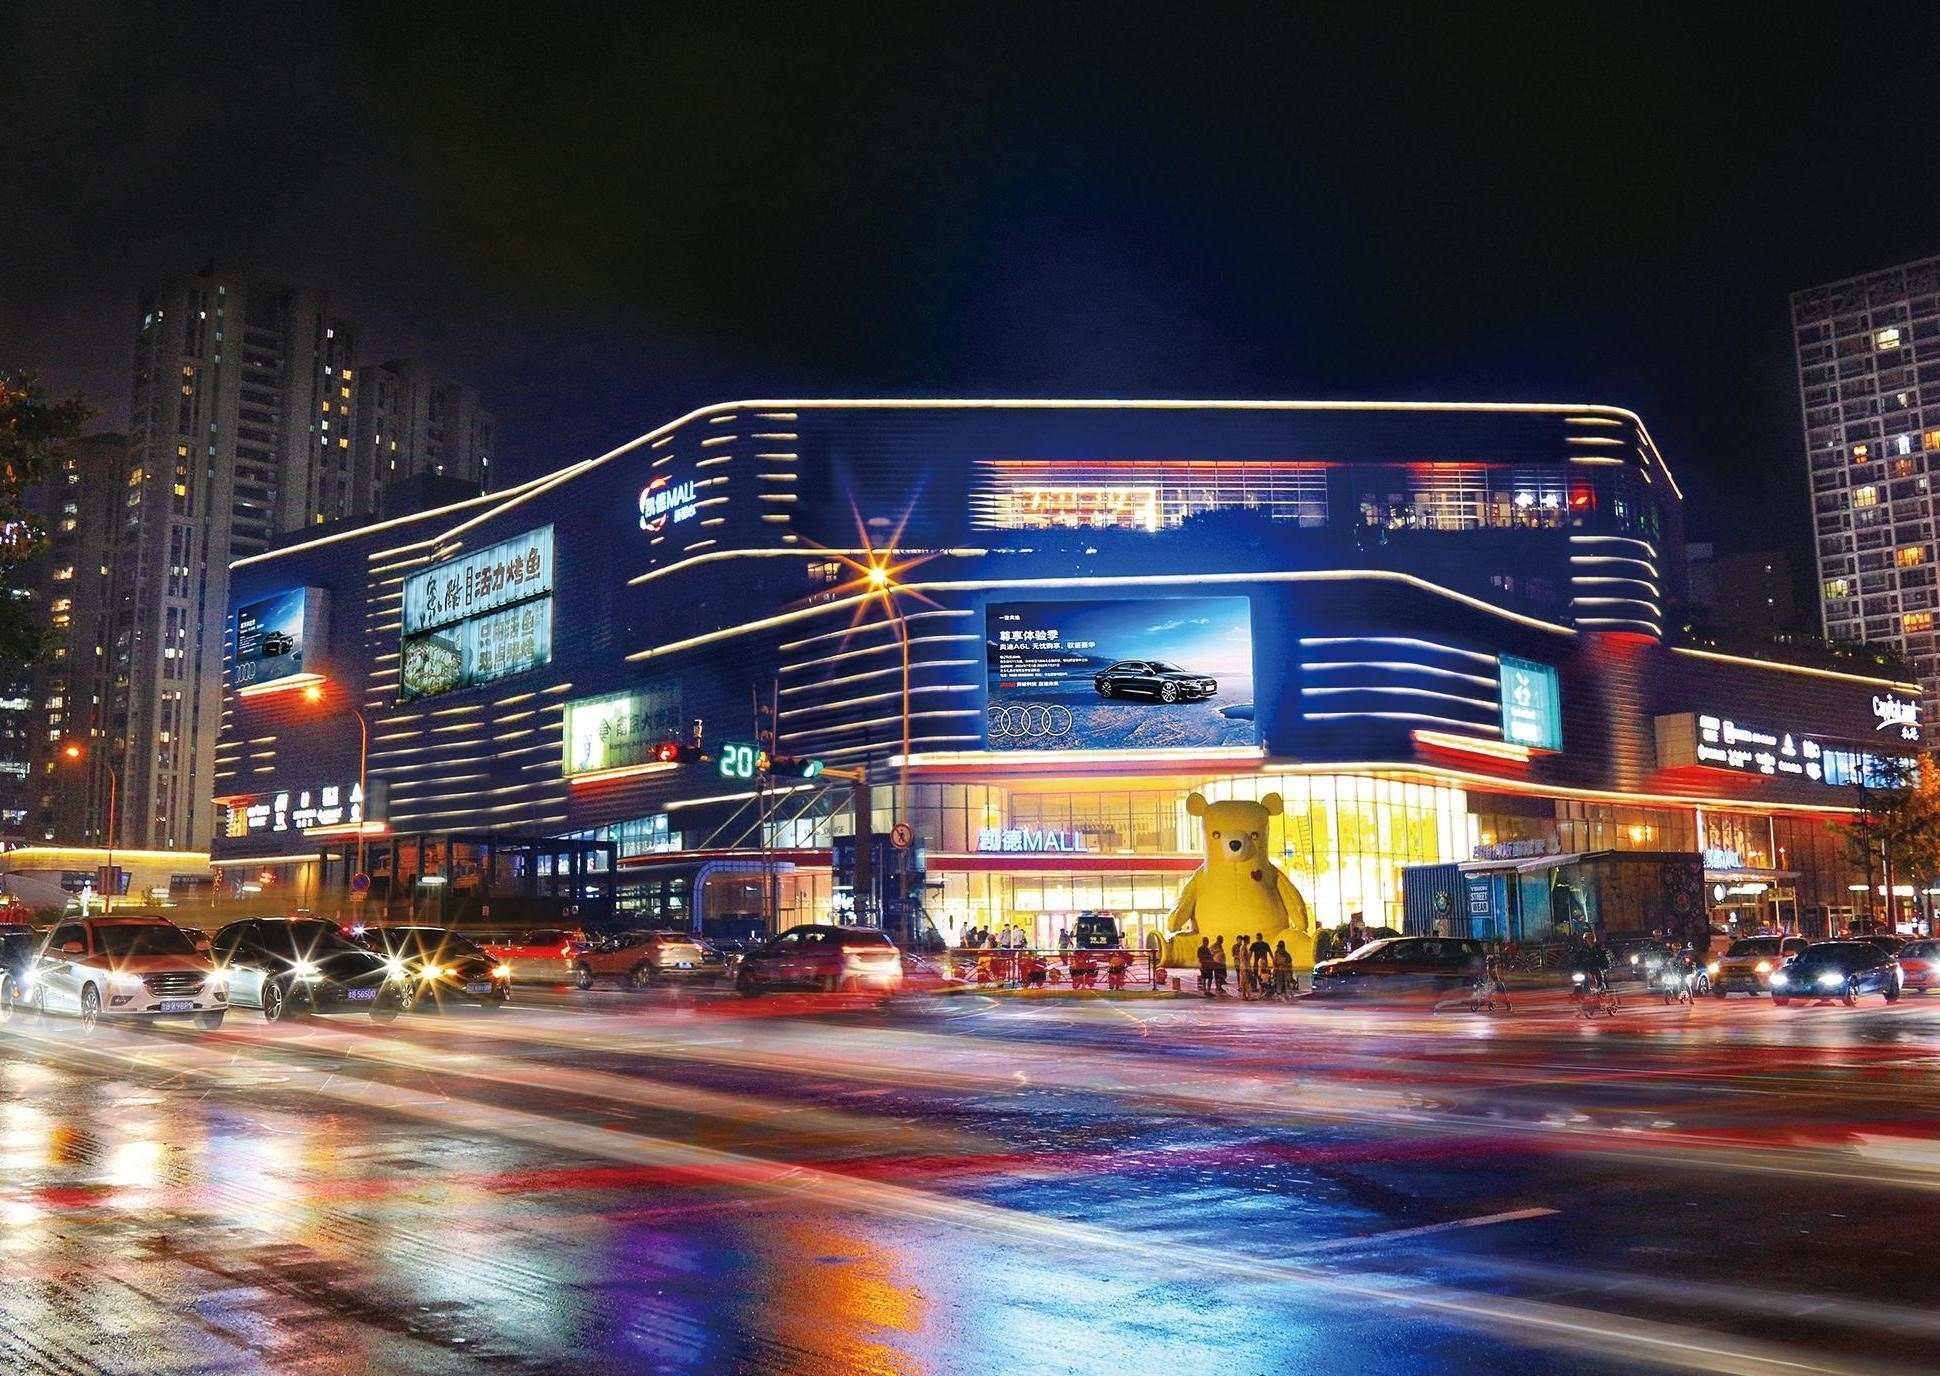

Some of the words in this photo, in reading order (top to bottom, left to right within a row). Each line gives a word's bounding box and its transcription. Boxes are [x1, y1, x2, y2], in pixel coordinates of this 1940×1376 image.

[474, 546, 541, 598] 活力烤鱼
[999, 629, 1060, 641] 尊享体验季
[720, 745, 753, 777] 20
[1470, 892, 1488, 901] STREET
[1472, 902, 1488, 912] WEAR
